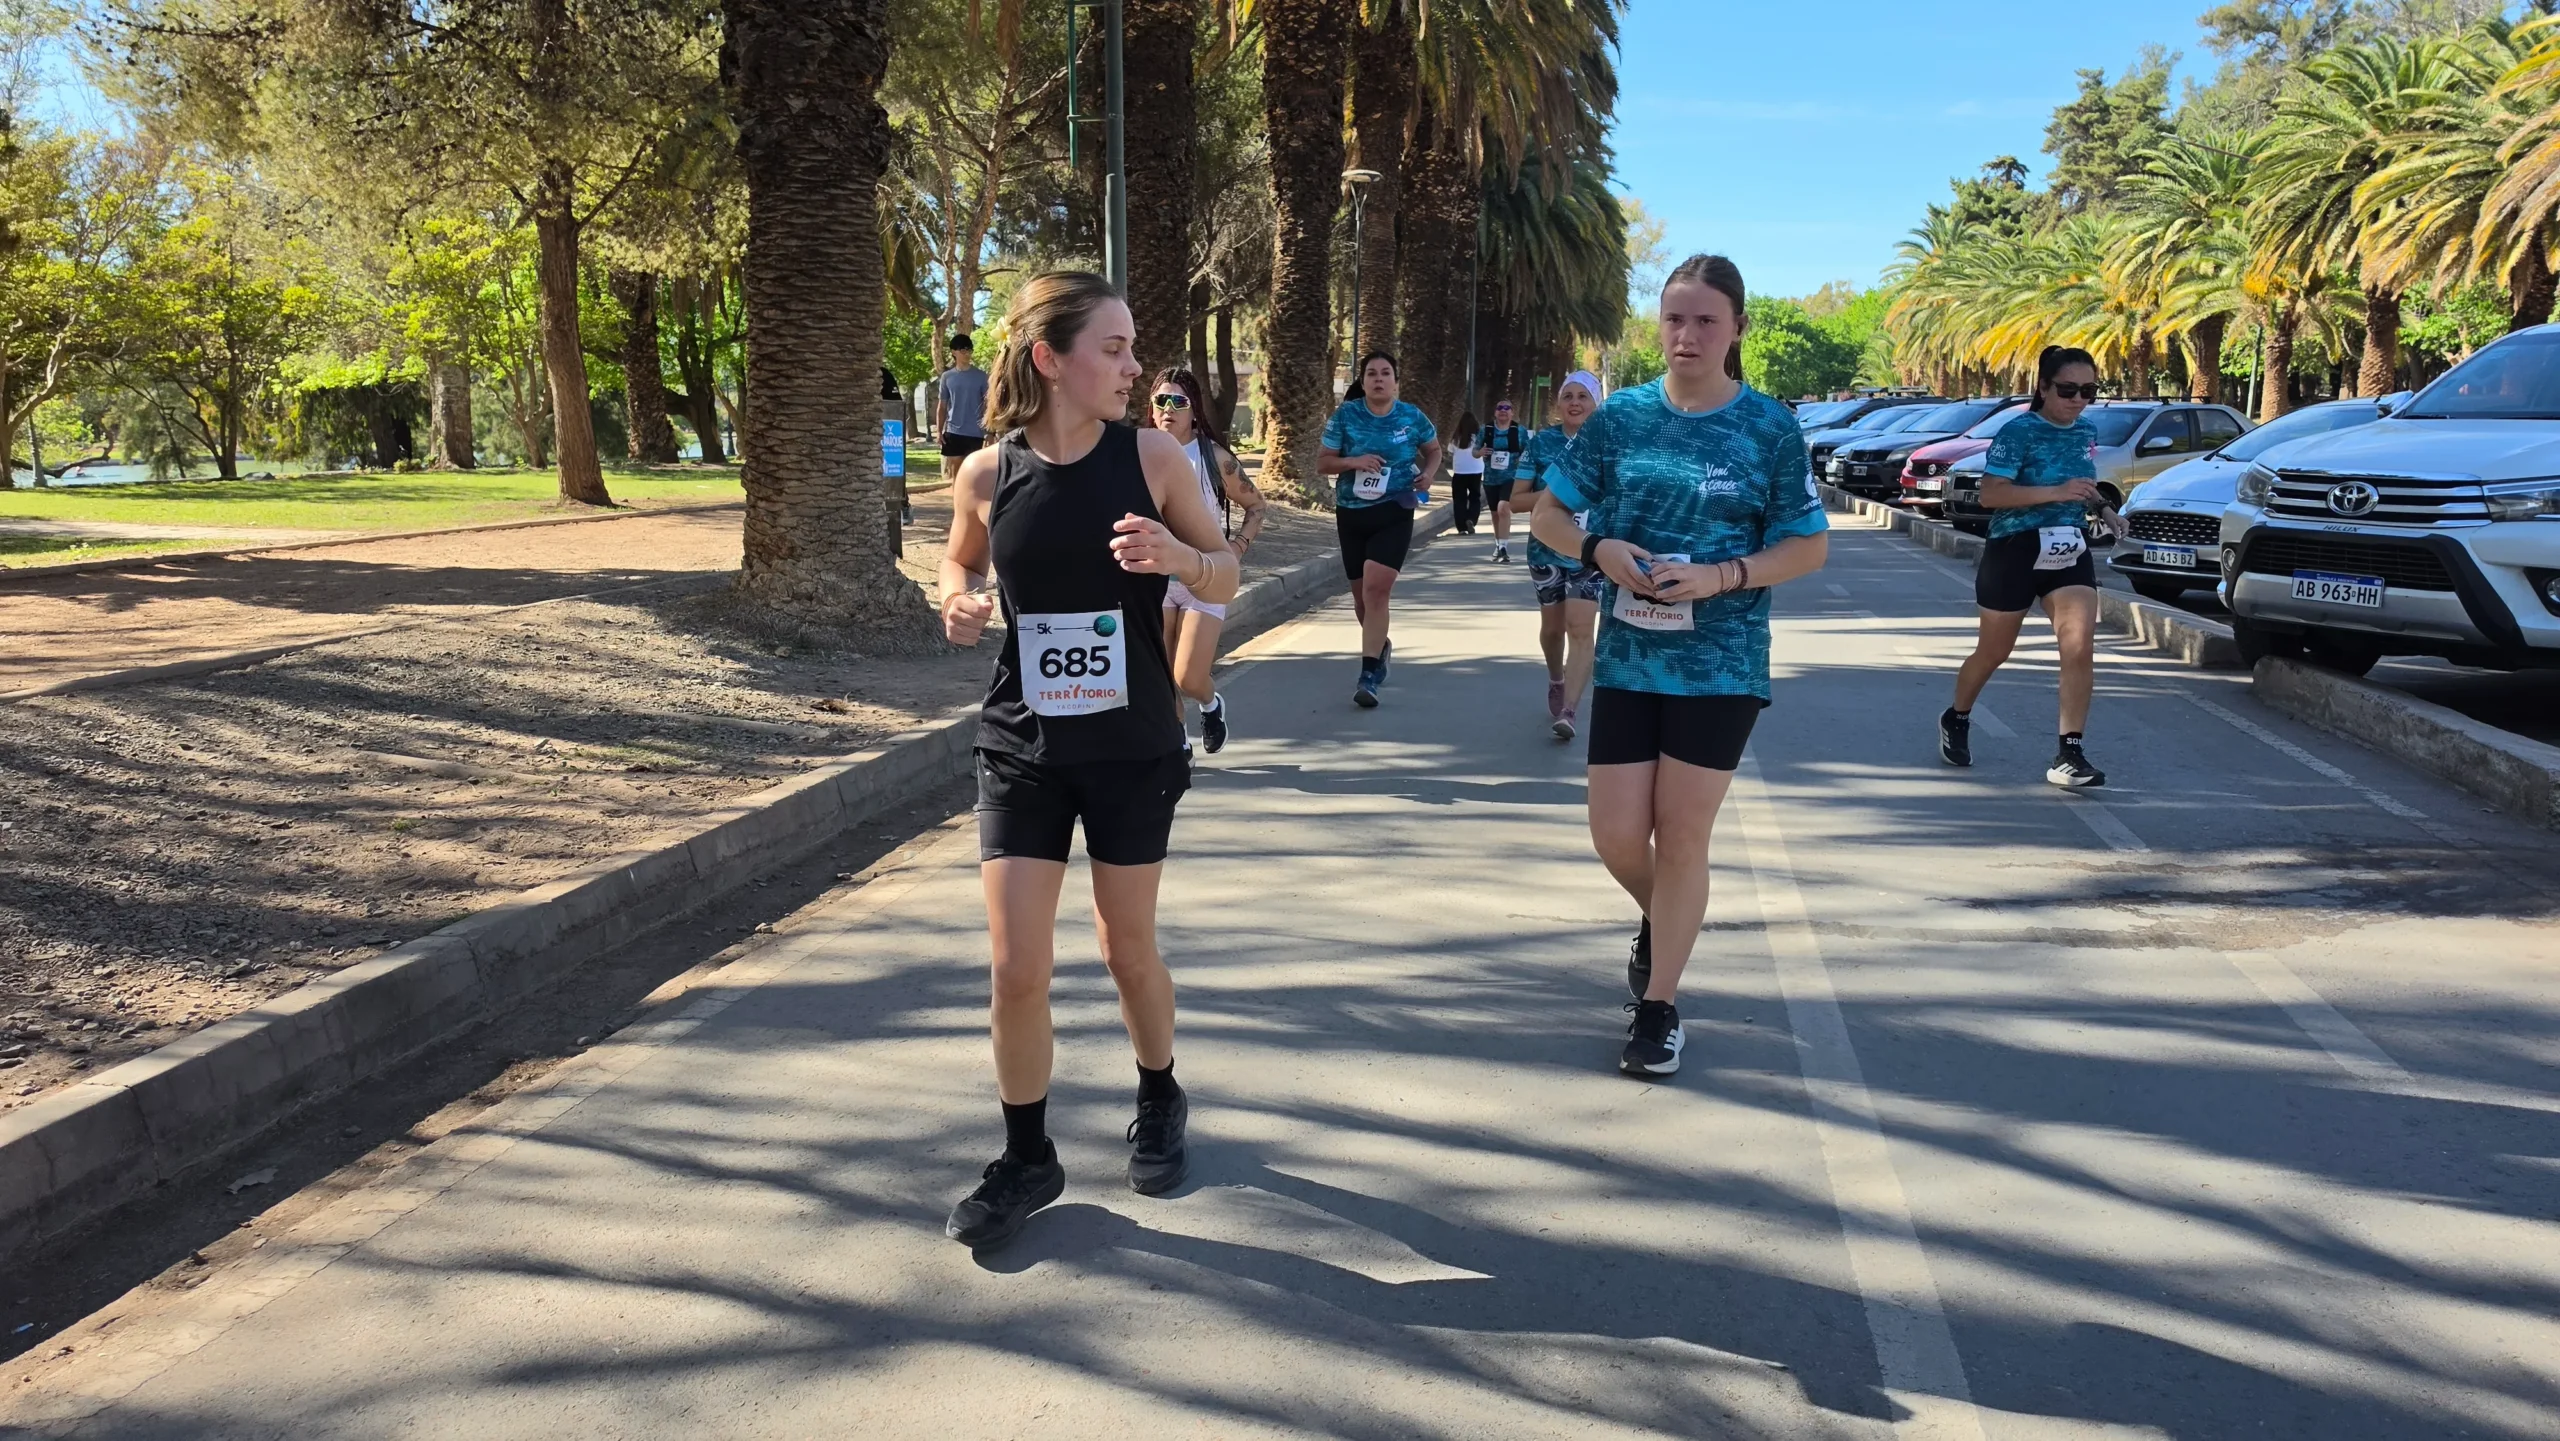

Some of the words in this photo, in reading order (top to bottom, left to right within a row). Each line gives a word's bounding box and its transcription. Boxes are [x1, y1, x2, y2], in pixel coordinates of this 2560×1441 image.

[1363, 477, 1380, 488] 611
[2322, 524, 2361, 533] HILUX
[2048, 542, 2078, 556] 524
[2145, 550, 2158, 562] AD
[2160, 552, 2178, 564] 413
[2180, 554, 2193, 566] BZ
[2296, 580, 2316, 598] AB
[2321, 583, 2352, 602] 963
[2356, 586, 2379, 606] HH
[1624, 606, 1684, 621] TERRITORIO
[1037, 623, 1052, 635] 5k
[1039, 645, 1111, 679] 685
[1039, 684, 1117, 701] TERRITORIO
